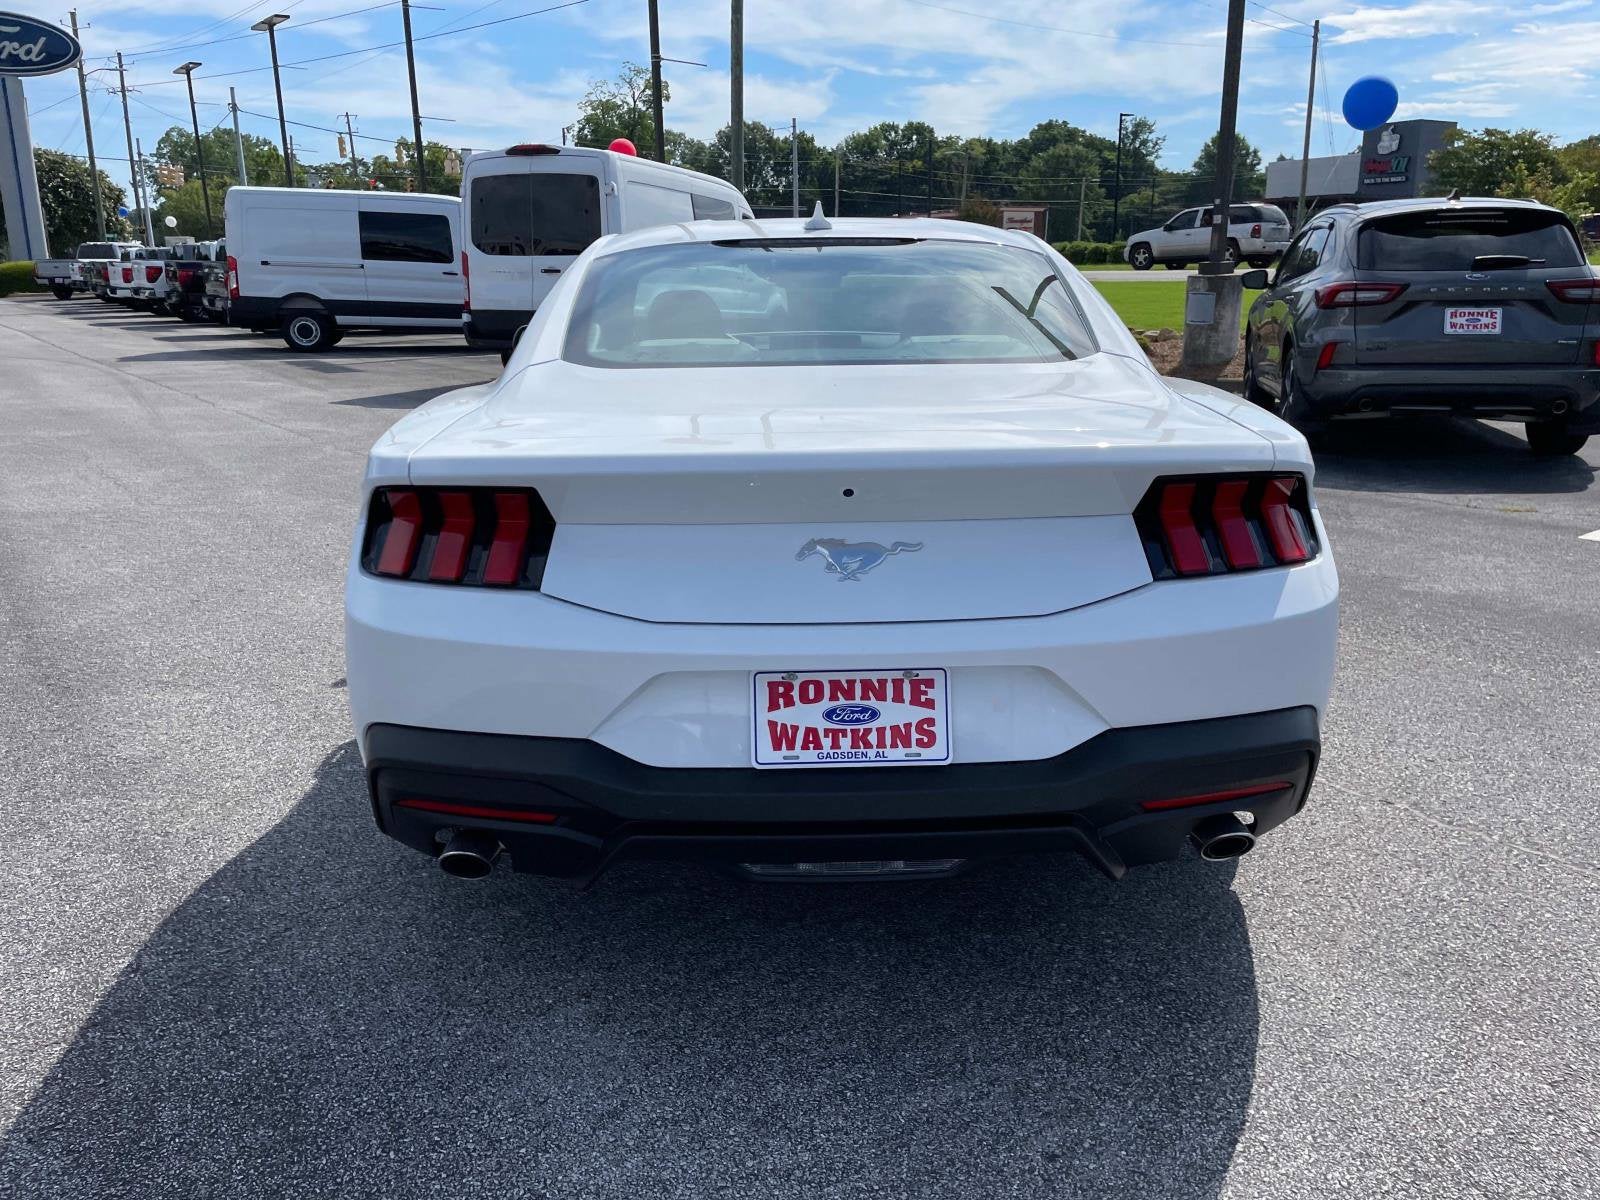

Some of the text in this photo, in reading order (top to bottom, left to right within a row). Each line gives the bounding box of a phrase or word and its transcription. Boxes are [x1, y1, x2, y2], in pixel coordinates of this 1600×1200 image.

[0, 26, 46, 61] rd
[1450, 321, 1497, 330] WATKINS
[767, 678, 936, 713] RONNIE
[831, 706, 872, 721] Ford
[768, 717, 937, 752] WATKINS
[817, 751, 888, 761] GADSDEN, AL
